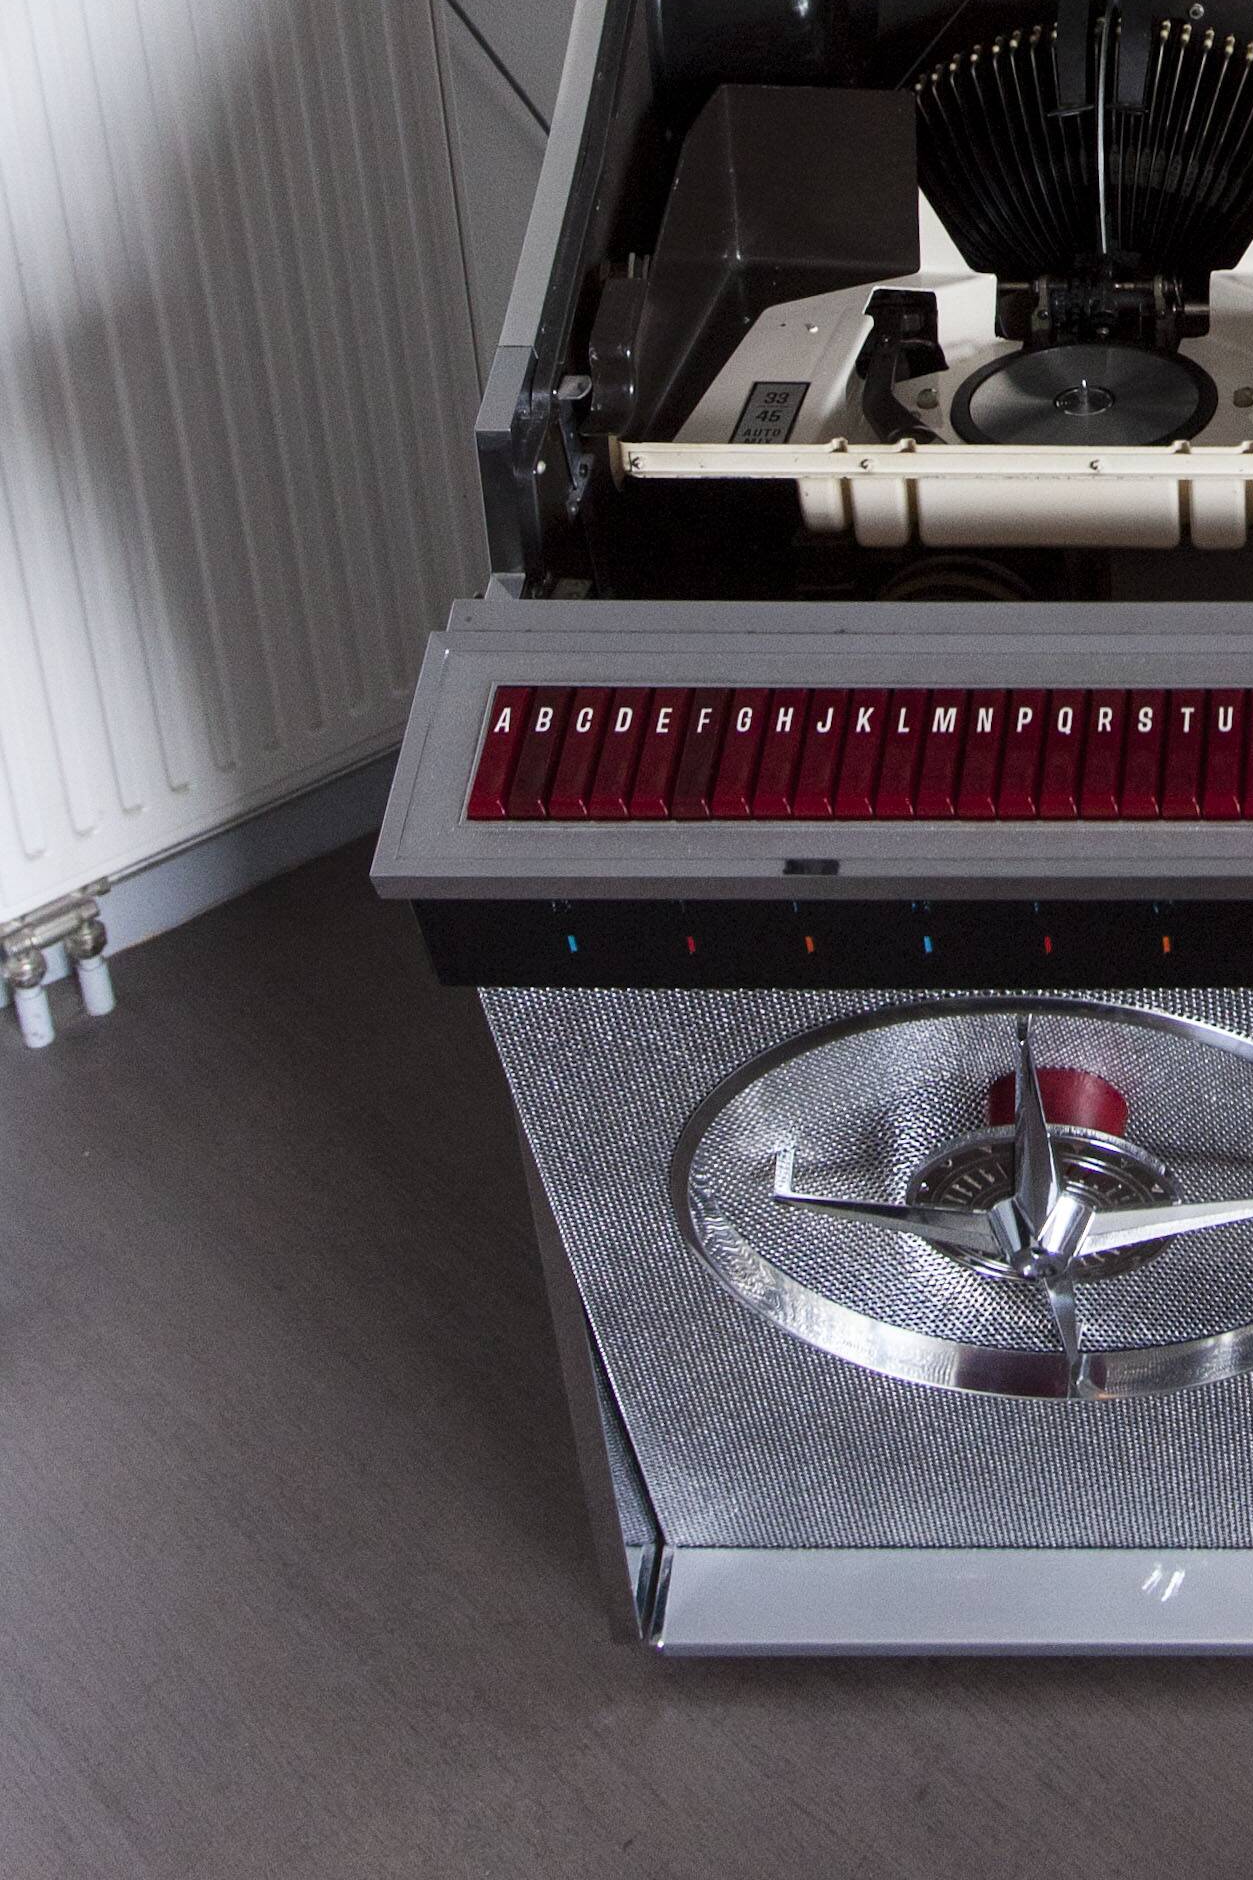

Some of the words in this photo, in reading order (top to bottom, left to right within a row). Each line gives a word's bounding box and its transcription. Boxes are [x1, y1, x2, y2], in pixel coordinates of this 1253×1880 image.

[764, 392, 790, 404] 33
[756, 410, 783, 422] 45
[742, 428, 781, 437] AUTO
[493, 707, 511, 733] A
[535, 706, 554, 732] B
[576, 707, 594, 733] C
[614, 707, 633, 733] D
[655, 707, 673, 733] E
[696, 707, 713, 733] F
[736, 706, 753, 732] G
[775, 707, 794, 732] H
[816, 707, 834, 733] J
[855, 707, 875, 733] K
[897, 707, 910, 733] L
[932, 707, 957, 733] M
[976, 707, 994, 733] N
[1016, 707, 1033, 733] P
[1057, 706, 1073, 735] Q
[1097, 706, 1113, 732] R
[1137, 706, 1153, 733] S
[1180, 707, 1195, 733] T
[1218, 706, 1234, 732] U
